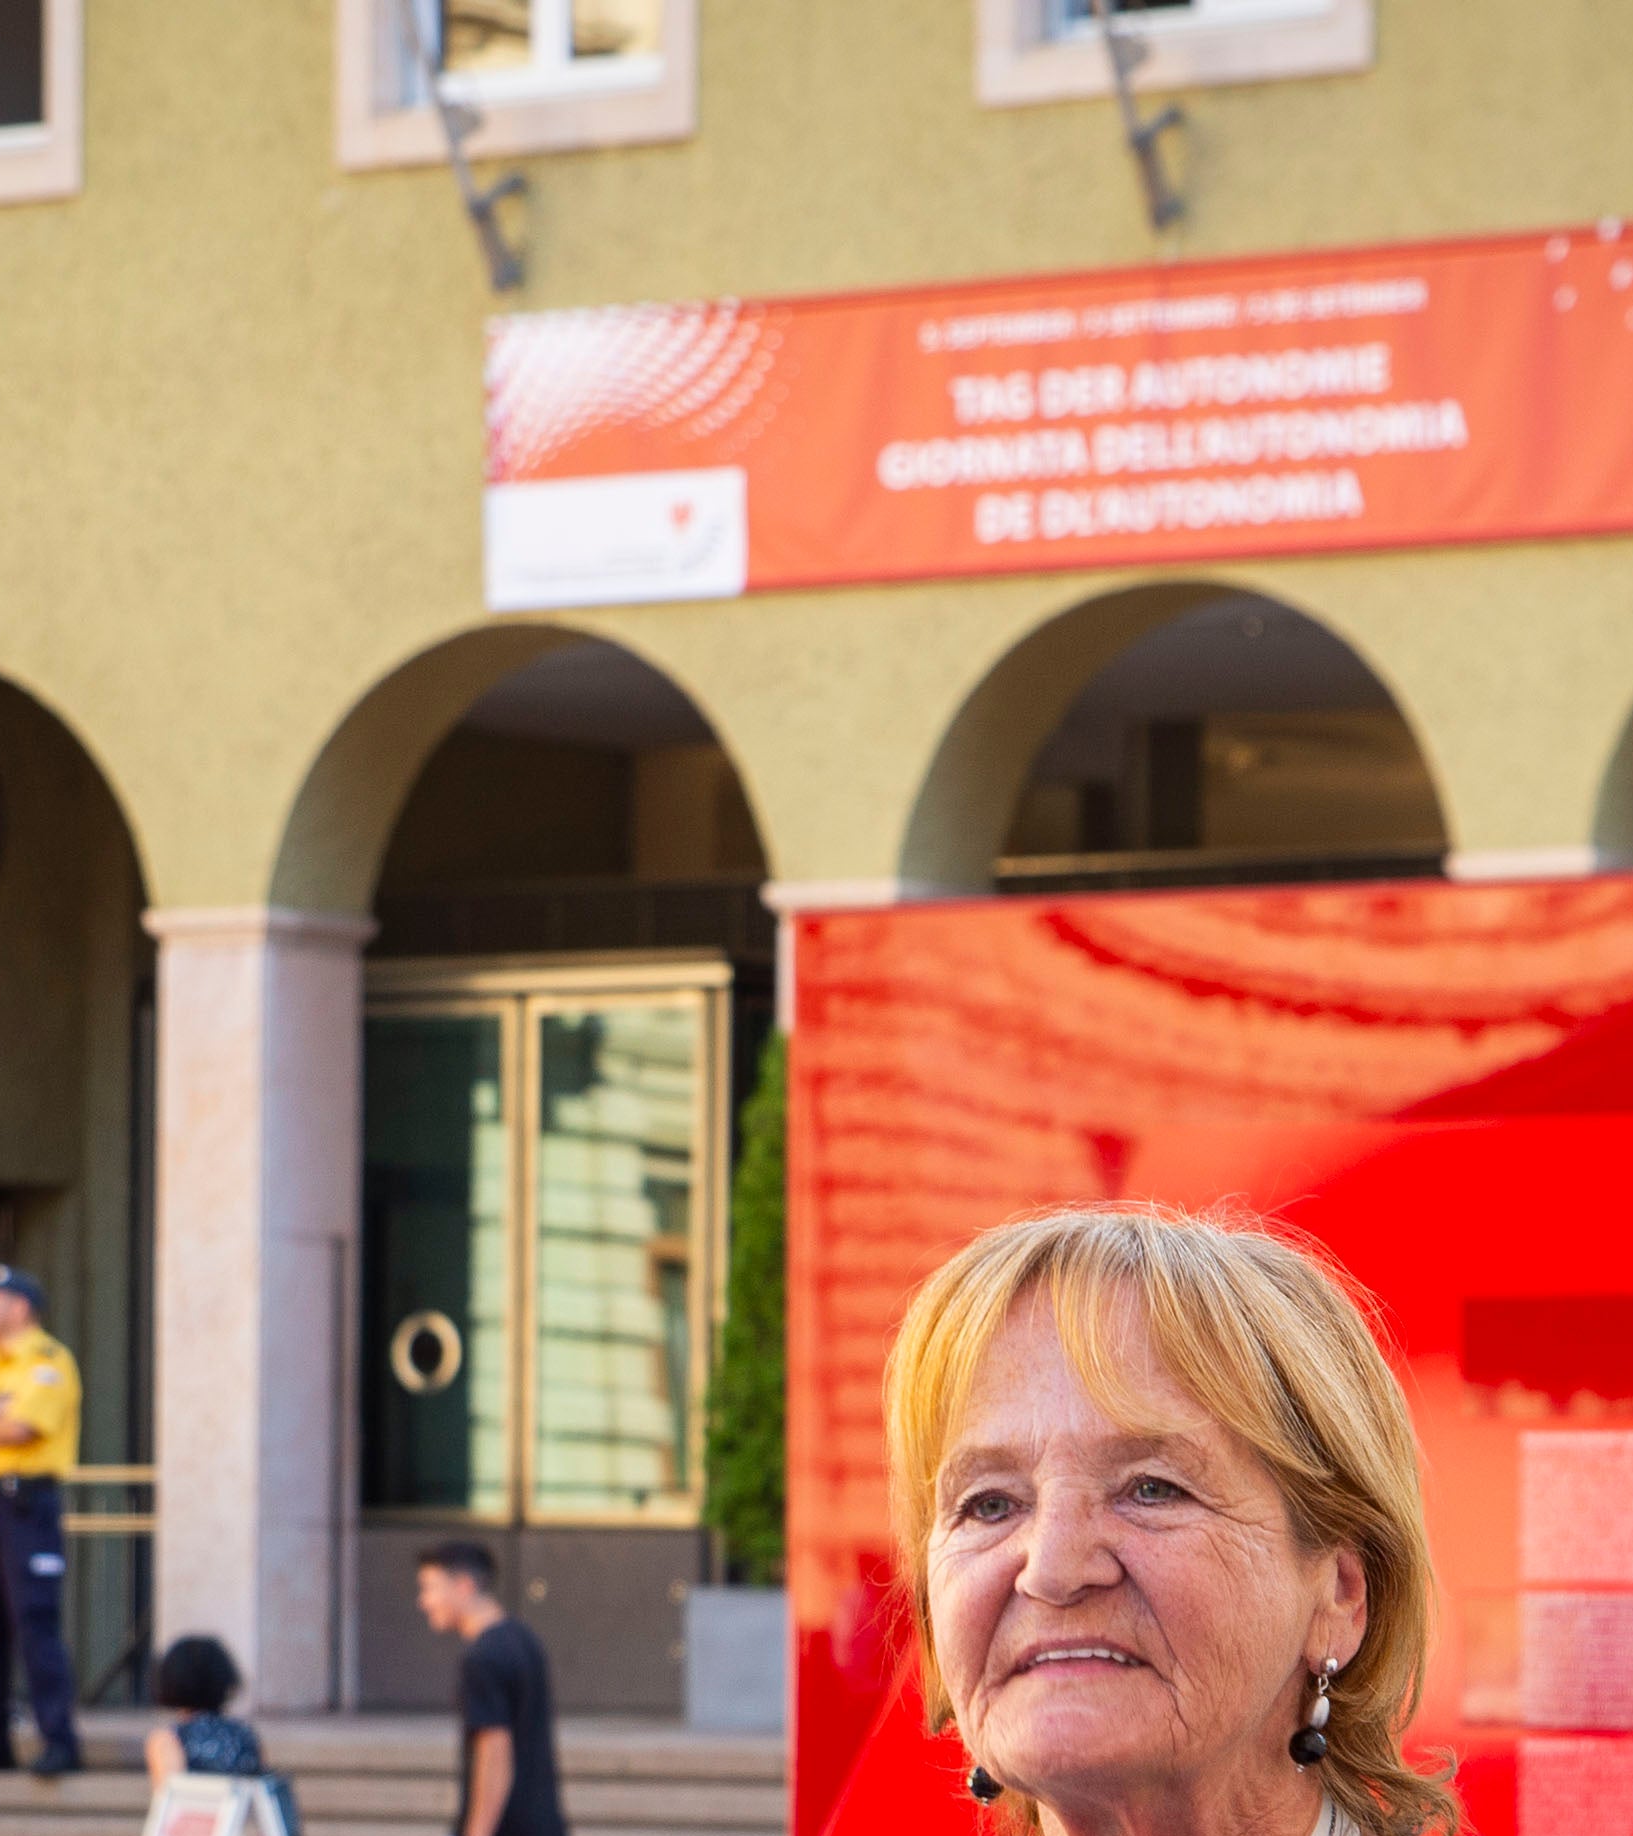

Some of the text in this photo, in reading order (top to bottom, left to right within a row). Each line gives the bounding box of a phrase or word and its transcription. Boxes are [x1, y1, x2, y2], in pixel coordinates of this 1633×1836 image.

[952, 342, 1390, 424] TAG DER AUTONOMIE
[878, 429, 1090, 490] GIORNATA
